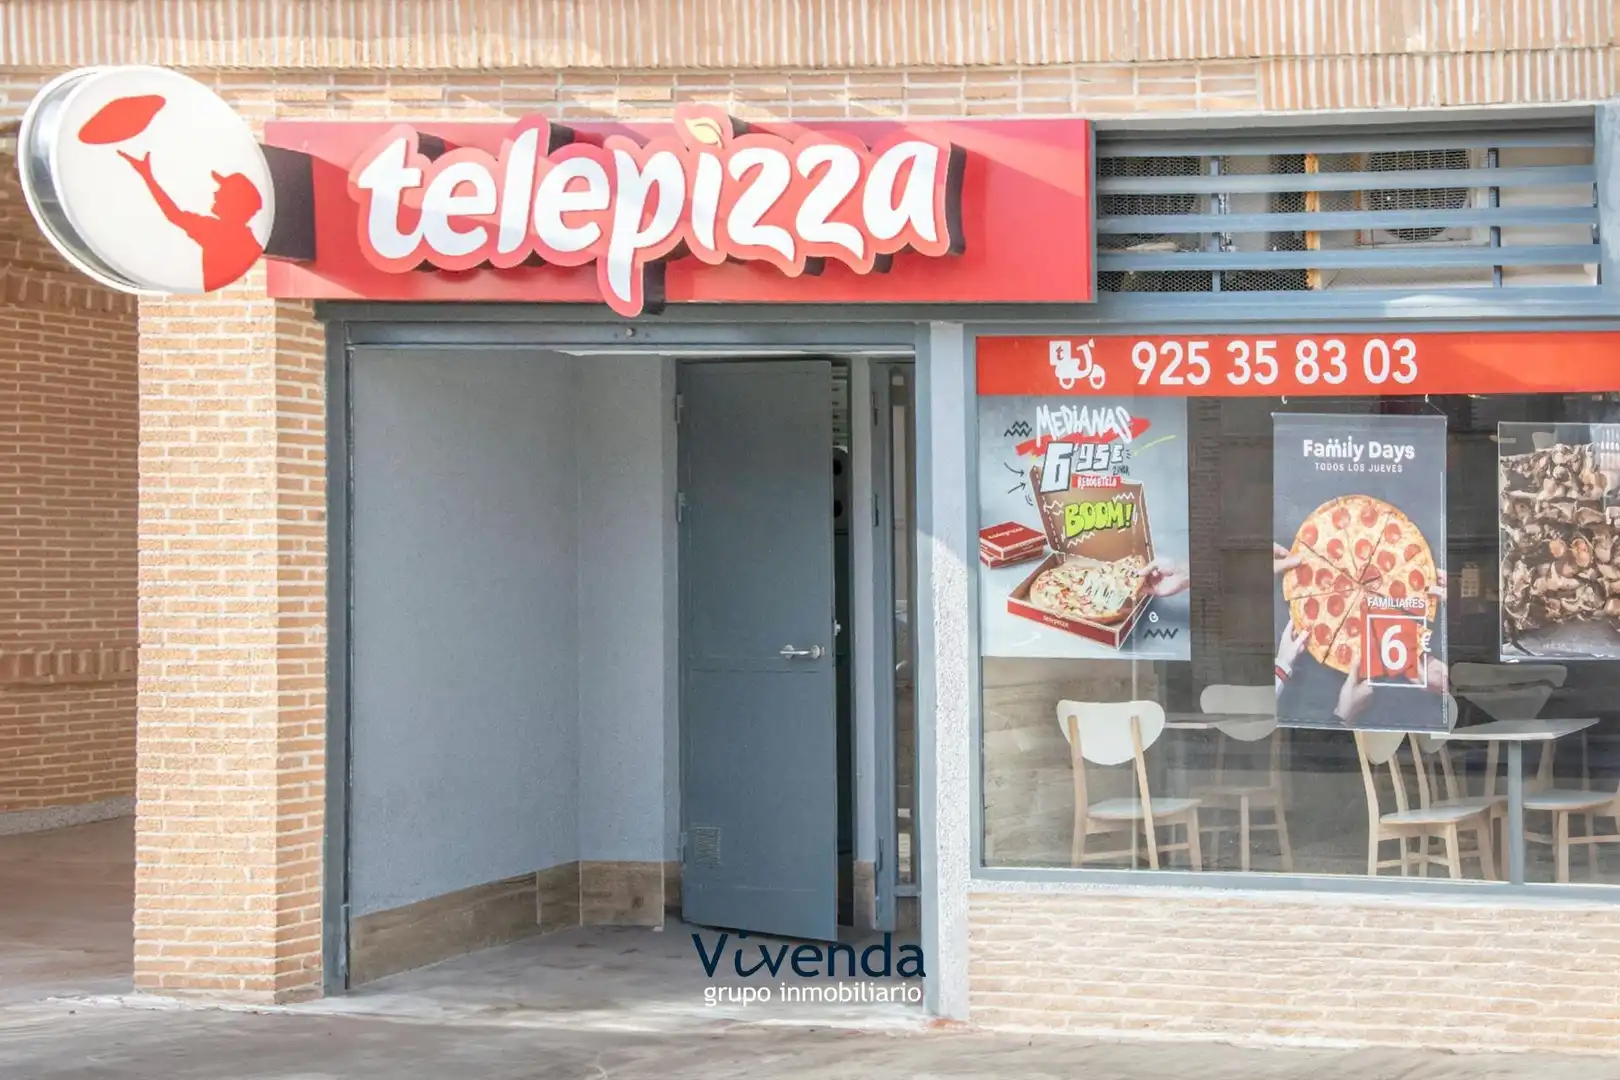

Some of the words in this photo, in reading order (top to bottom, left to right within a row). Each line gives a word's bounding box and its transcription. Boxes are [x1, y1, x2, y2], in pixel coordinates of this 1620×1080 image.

[358, 118, 940, 302] telepizza
[1131, 341, 1211, 385] 925
[1226, 340, 1278, 385] 35
[1295, 339, 1347, 384] 83
[1363, 338, 1418, 384] 03
[1303, 436, 1364, 462] Family
[1369, 441, 1415, 463] Days
[1315, 463, 1344, 472] TODOS
[1348, 463, 1365, 472] LOS
[1369, 464, 1403, 473] JUEVES
[1065, 501, 1134, 539] BOOM!
[1367, 597, 1425, 609] FAMILIARES
